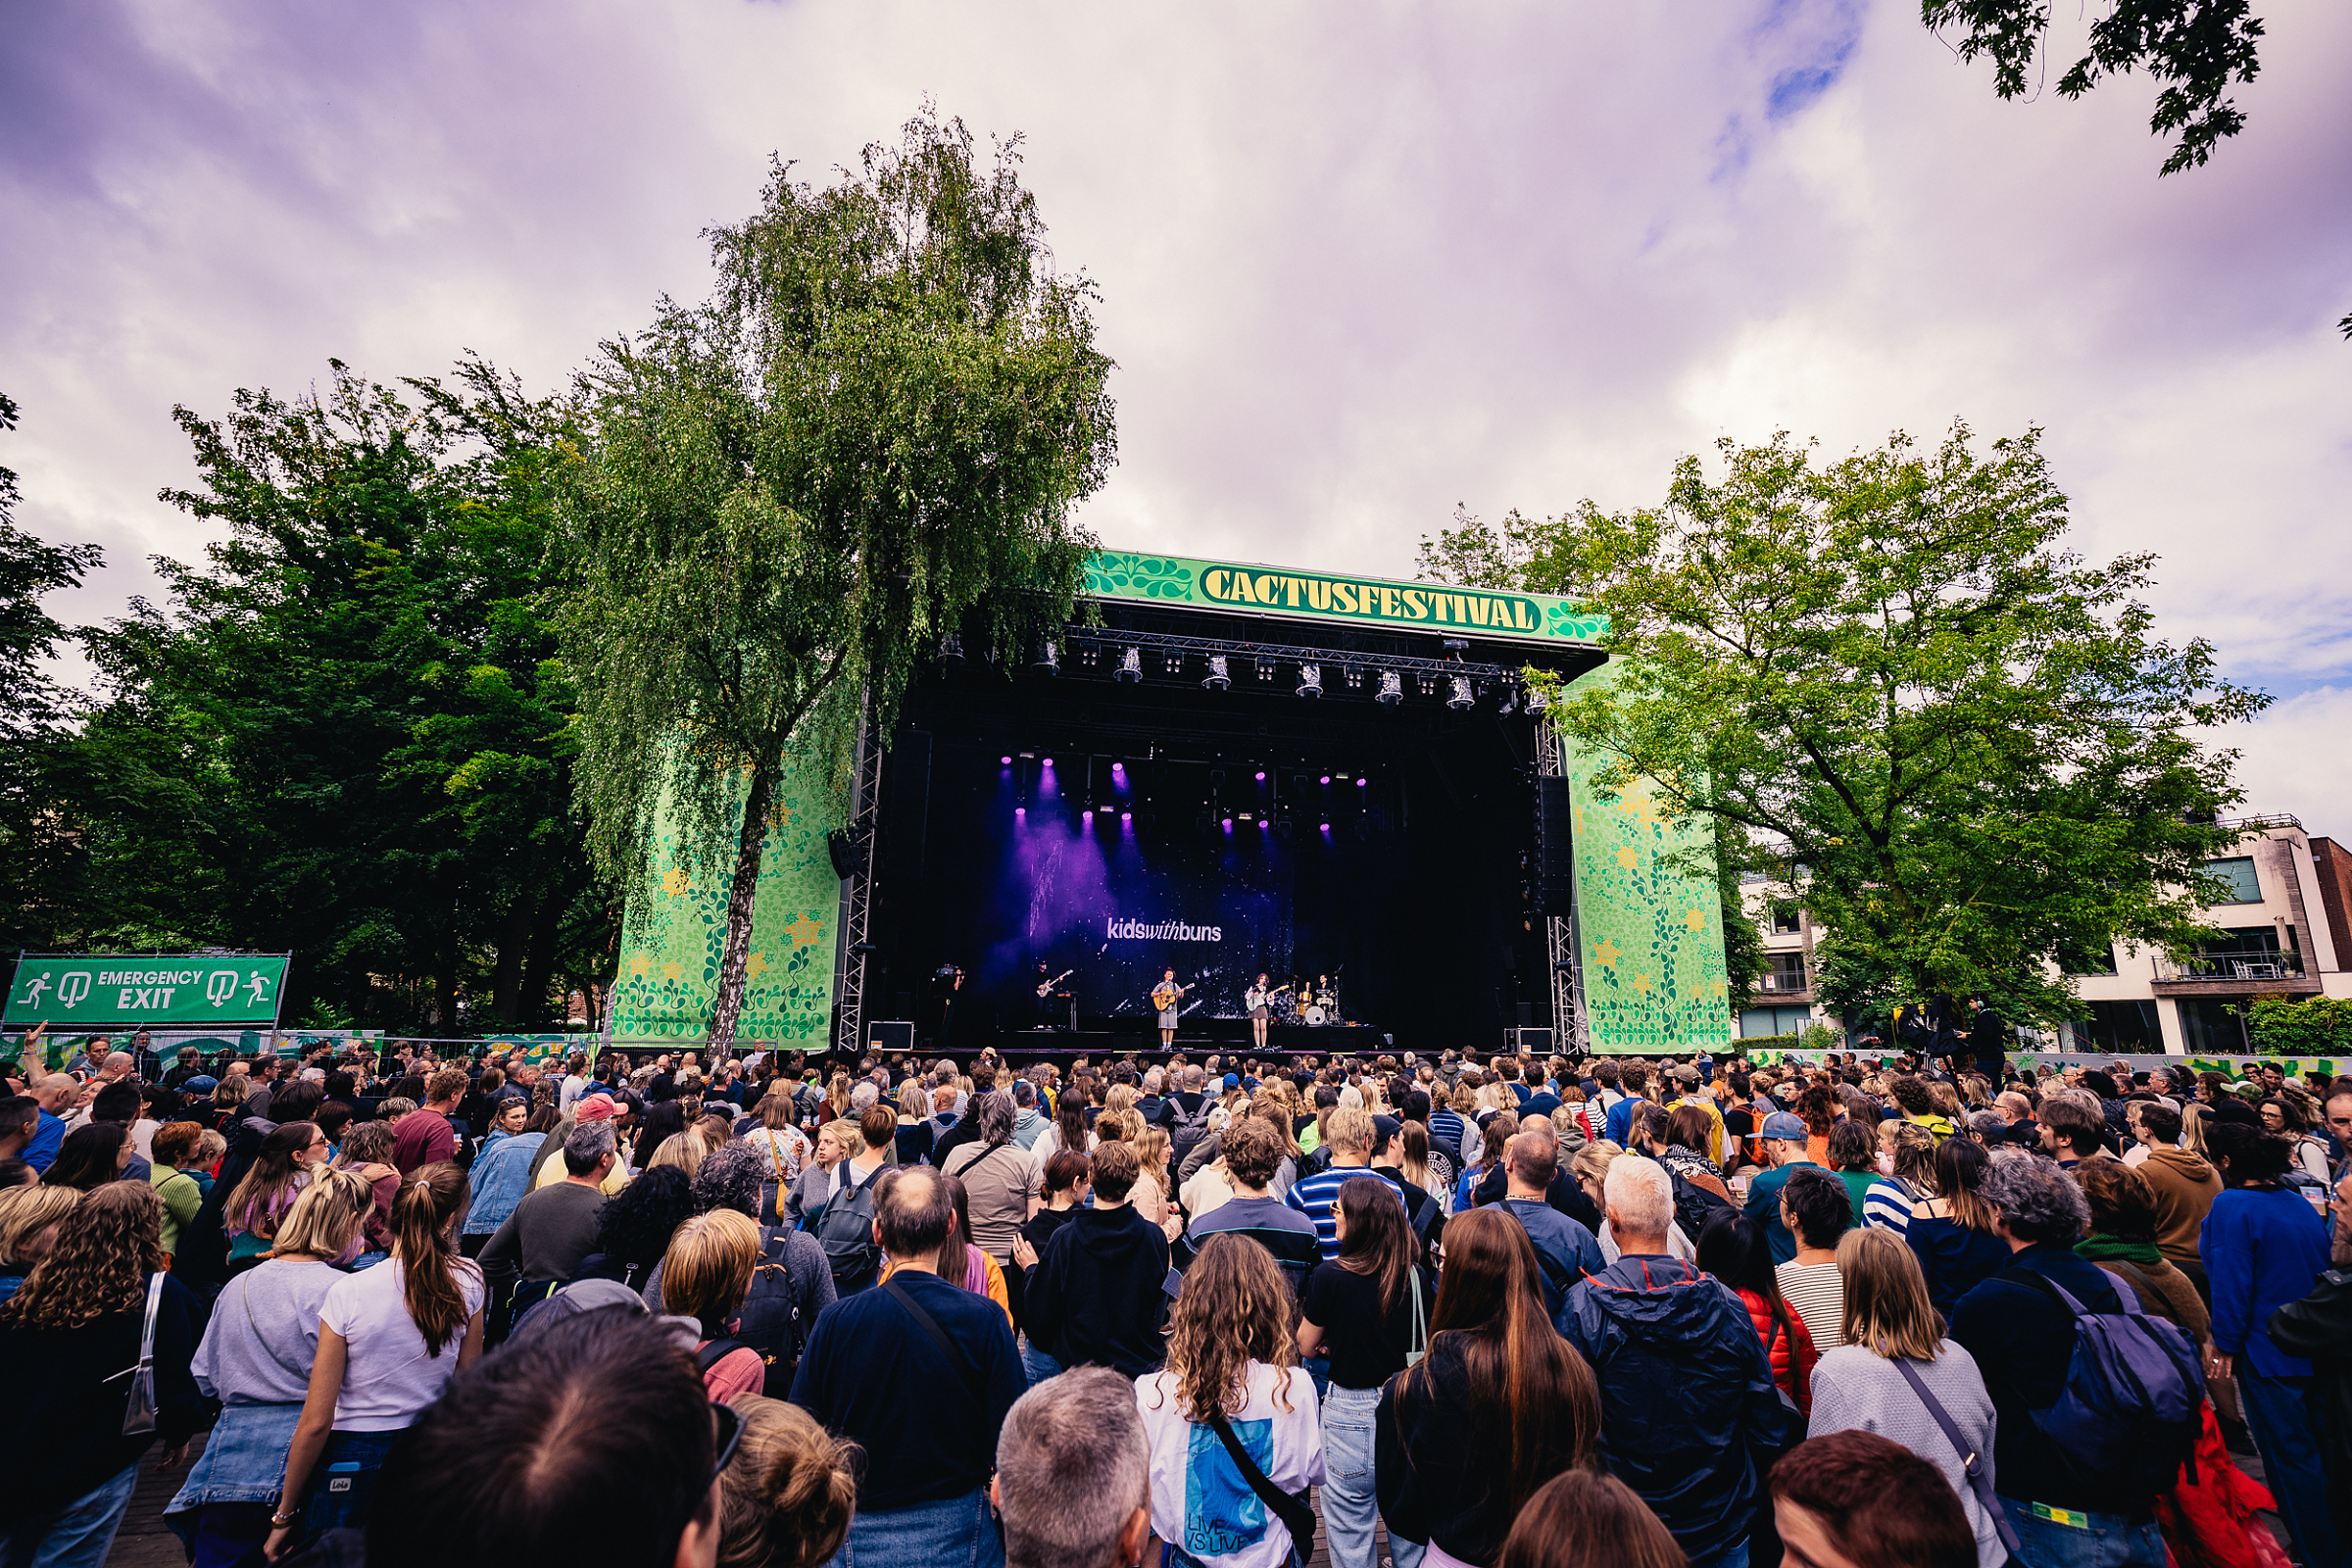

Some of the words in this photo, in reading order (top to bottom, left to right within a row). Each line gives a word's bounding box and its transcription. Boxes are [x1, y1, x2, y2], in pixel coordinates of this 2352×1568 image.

[1205, 569, 1535, 629] CACTUSFESTIVAL
[1107, 917, 1221, 941] kidswithbuns
[98, 970, 203, 985] EMERGENCY
[117, 988, 175, 1009] EXIT
[1188, 1513, 1225, 1535] LIVE
